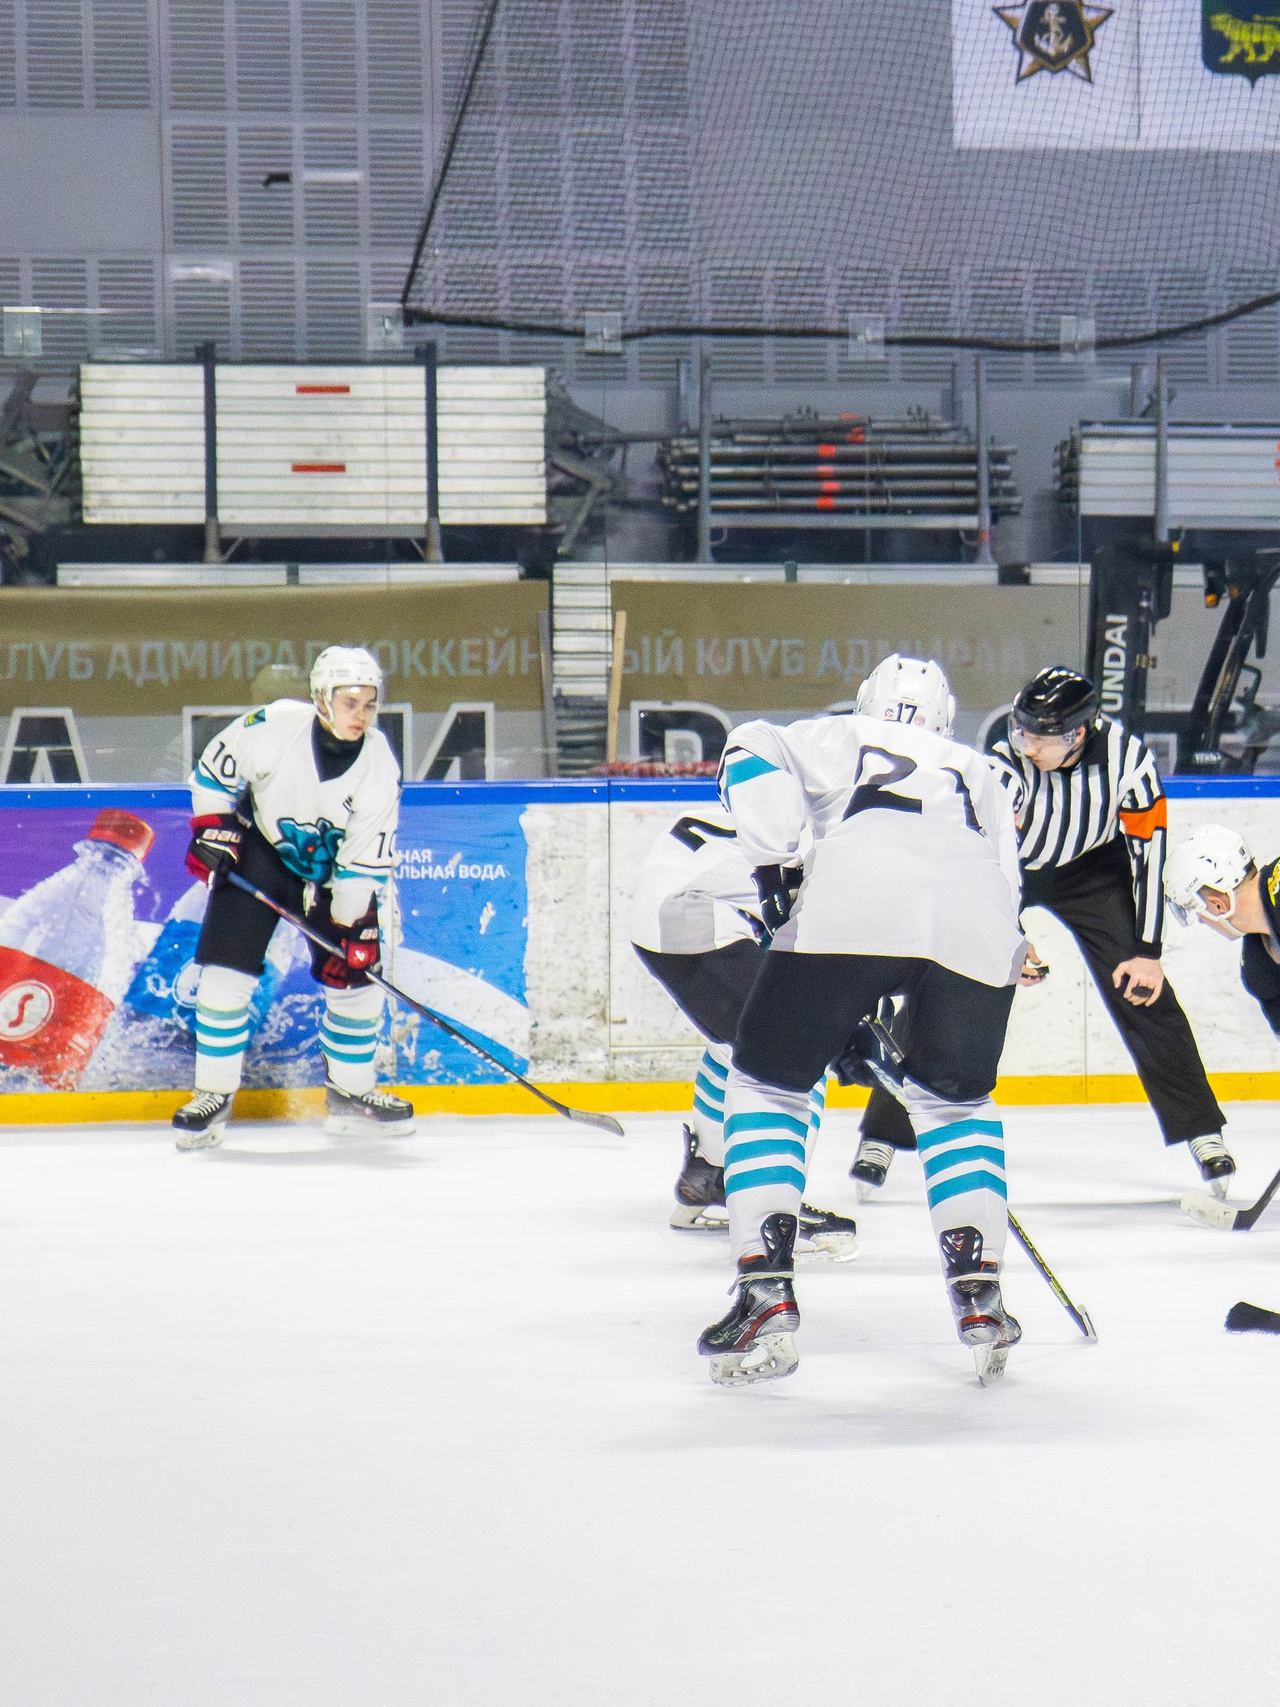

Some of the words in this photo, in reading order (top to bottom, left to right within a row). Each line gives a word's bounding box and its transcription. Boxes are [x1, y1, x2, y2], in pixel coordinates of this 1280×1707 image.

[695, 637, 805, 676] КЛУБ
[1099, 613, 1128, 723] UNDAI
[896, 702, 918, 725] 17
[212, 741, 237, 778] 10
[397, 849, 433, 864] НАЯ
[458, 864, 507, 882] ВОДА
